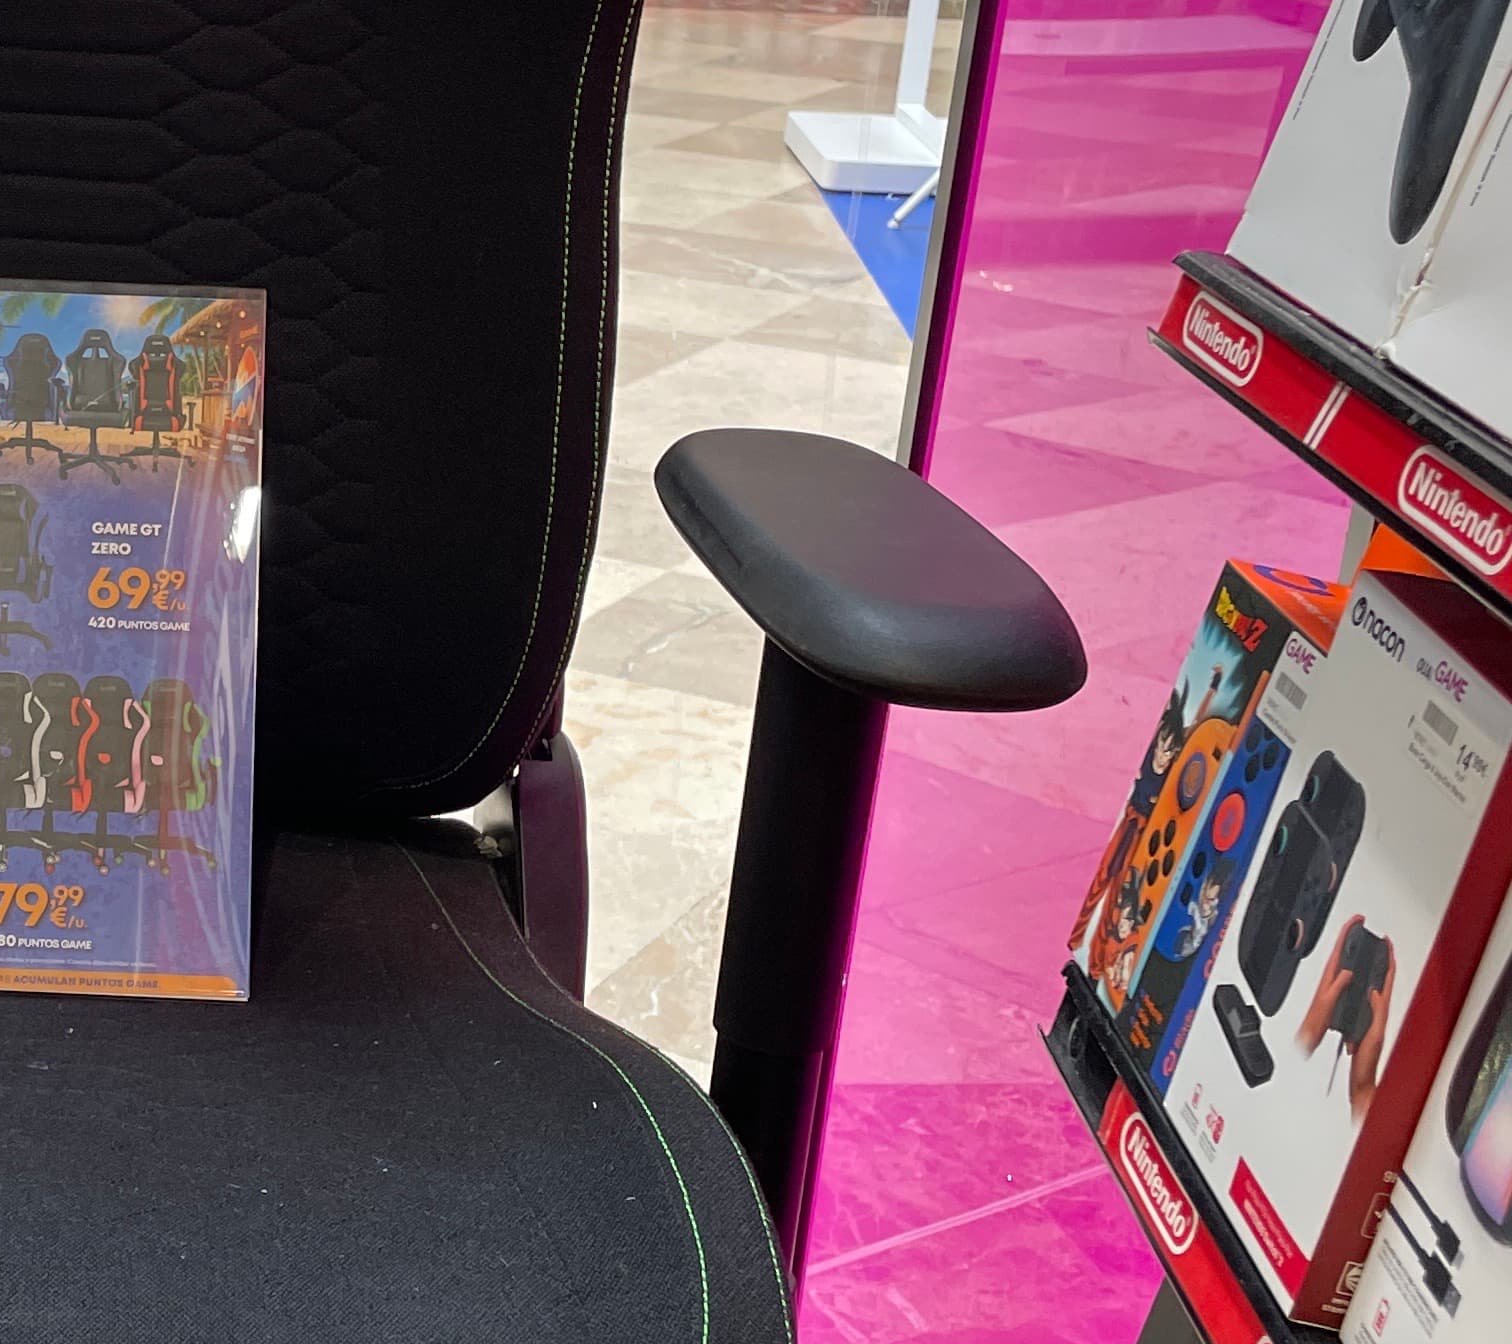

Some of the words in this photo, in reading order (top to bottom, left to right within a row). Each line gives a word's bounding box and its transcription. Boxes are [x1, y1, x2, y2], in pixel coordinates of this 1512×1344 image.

[1190, 306, 1252, 372] Nintendo
[1409, 462, 1506, 557] Nintendo
[91, 522, 137, 536] GAME
[140, 524, 162, 536] GT
[91, 542, 132, 555] ZERO
[88, 616, 116, 629] 420
[118, 620, 159, 631] PUNTOS
[160, 621, 190, 632] GAME
[1363, 605, 1406, 663] nacon
[1285, 637, 1316, 675] GAME
[1434, 660, 1468, 702] GAME
[17, 938, 59, 949] PUNTOS
[61, 939, 92, 950] GAME
[13, 975, 77, 987] ACUMULAN
[79, 977, 123, 987] PUNTOS
[1127, 1128, 1188, 1241] Nintendo
